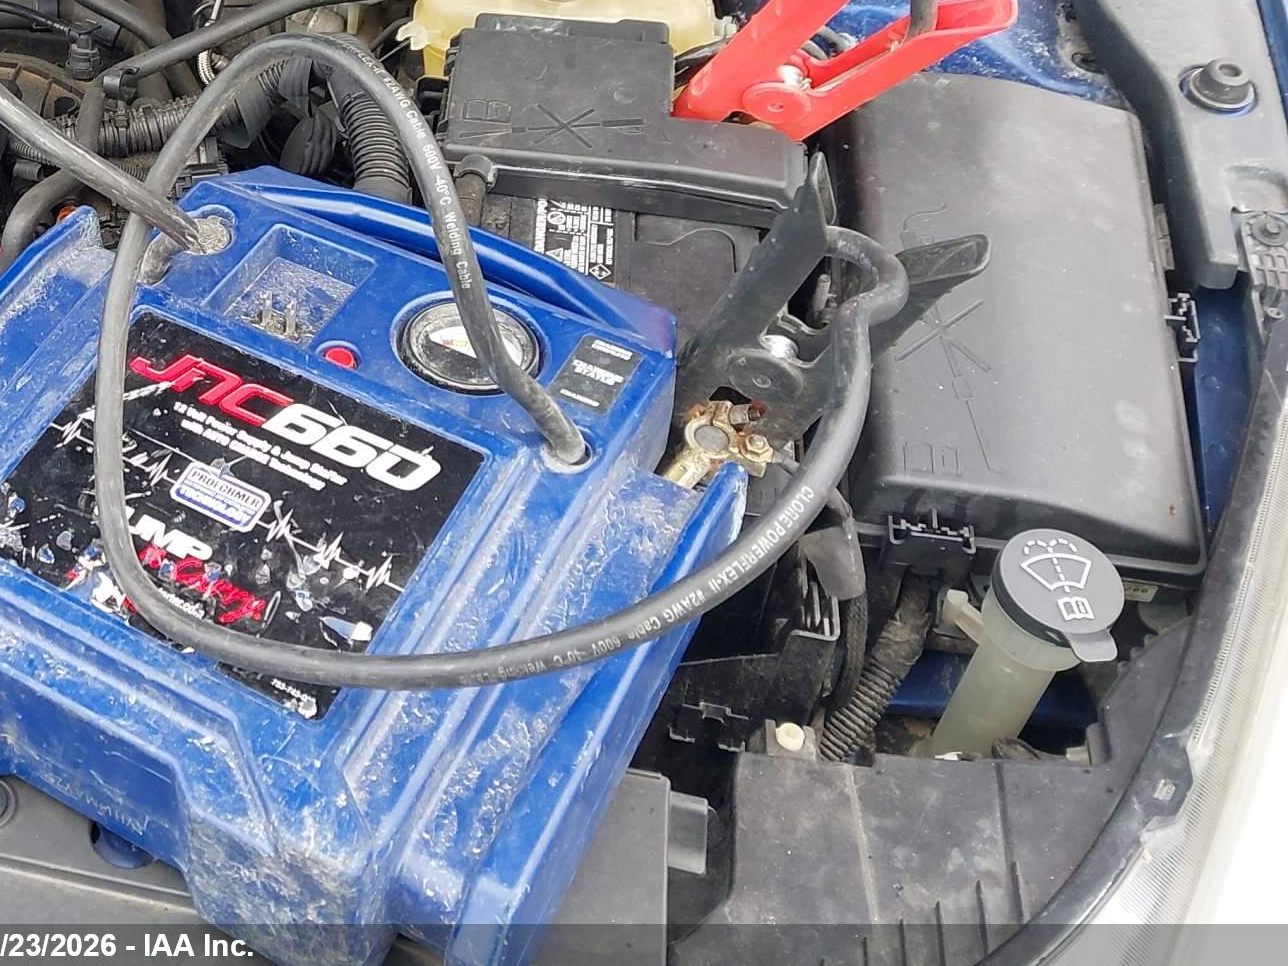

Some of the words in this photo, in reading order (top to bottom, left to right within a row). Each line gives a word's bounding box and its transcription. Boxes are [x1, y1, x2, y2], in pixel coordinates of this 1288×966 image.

[406, 109, 426, 139] Cable
[422, 144, 442, 170] 600V
[442, 212, 462, 256] Welding
[455, 261, 471, 289] Cable
[129, 354, 441, 491] JNC660
[94, 505, 212, 561] UMP
[778, 485, 815, 532] CLORE
[663, 588, 706, 623] #2AWG
[591, 637, 622, 657] 600V
